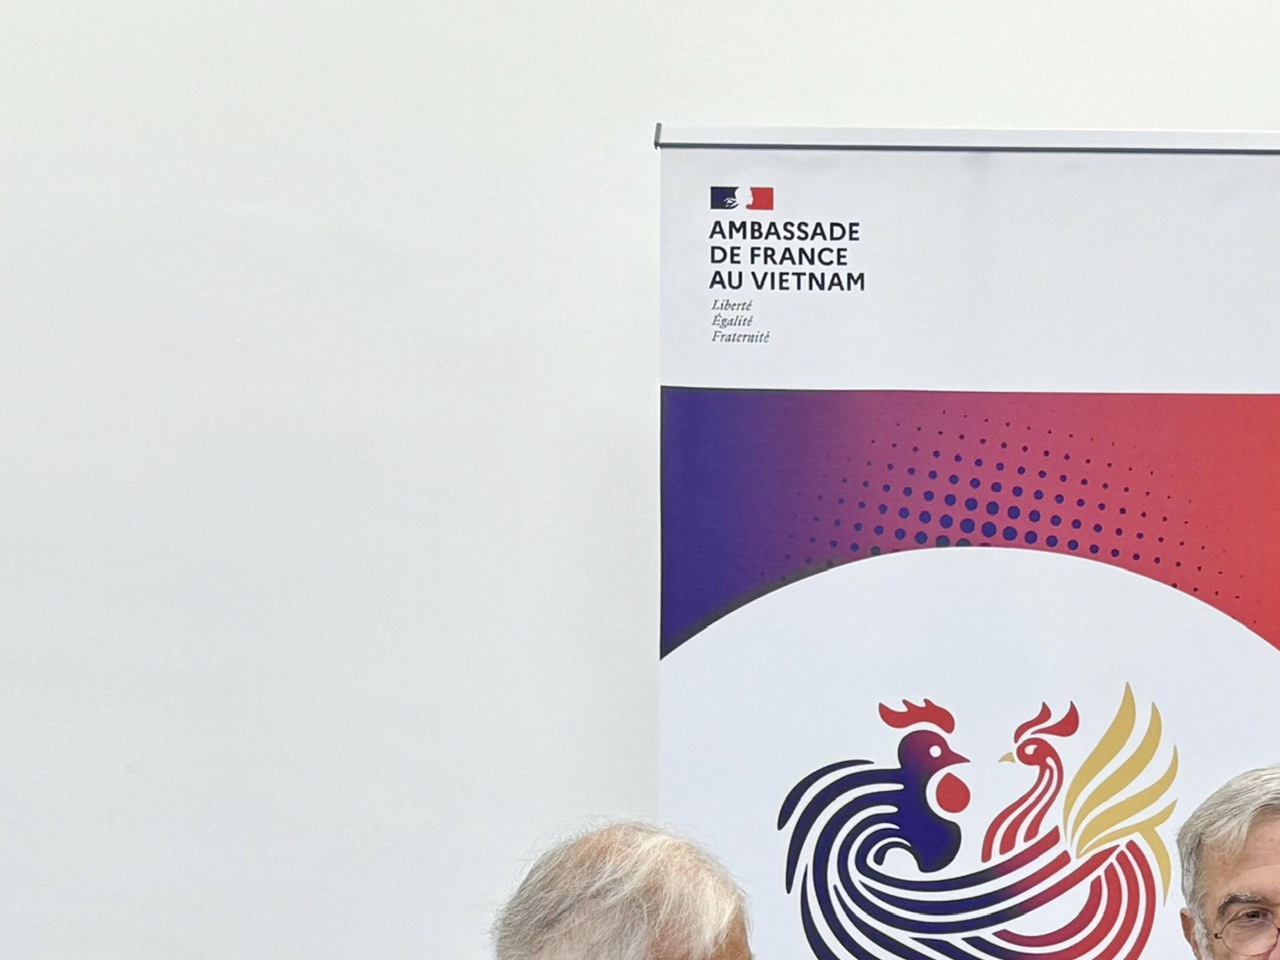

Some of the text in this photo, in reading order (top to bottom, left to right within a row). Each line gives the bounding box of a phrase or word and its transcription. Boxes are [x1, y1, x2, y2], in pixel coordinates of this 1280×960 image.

[708, 220, 860, 242] AMBASSADE
[710, 245, 848, 267] DE FRANCE
[708, 270, 865, 292] AU VIETNAM
[711, 299, 753, 312] Liberté
[711, 313, 754, 329] Égalité
[711, 331, 770, 344] Fraternité
